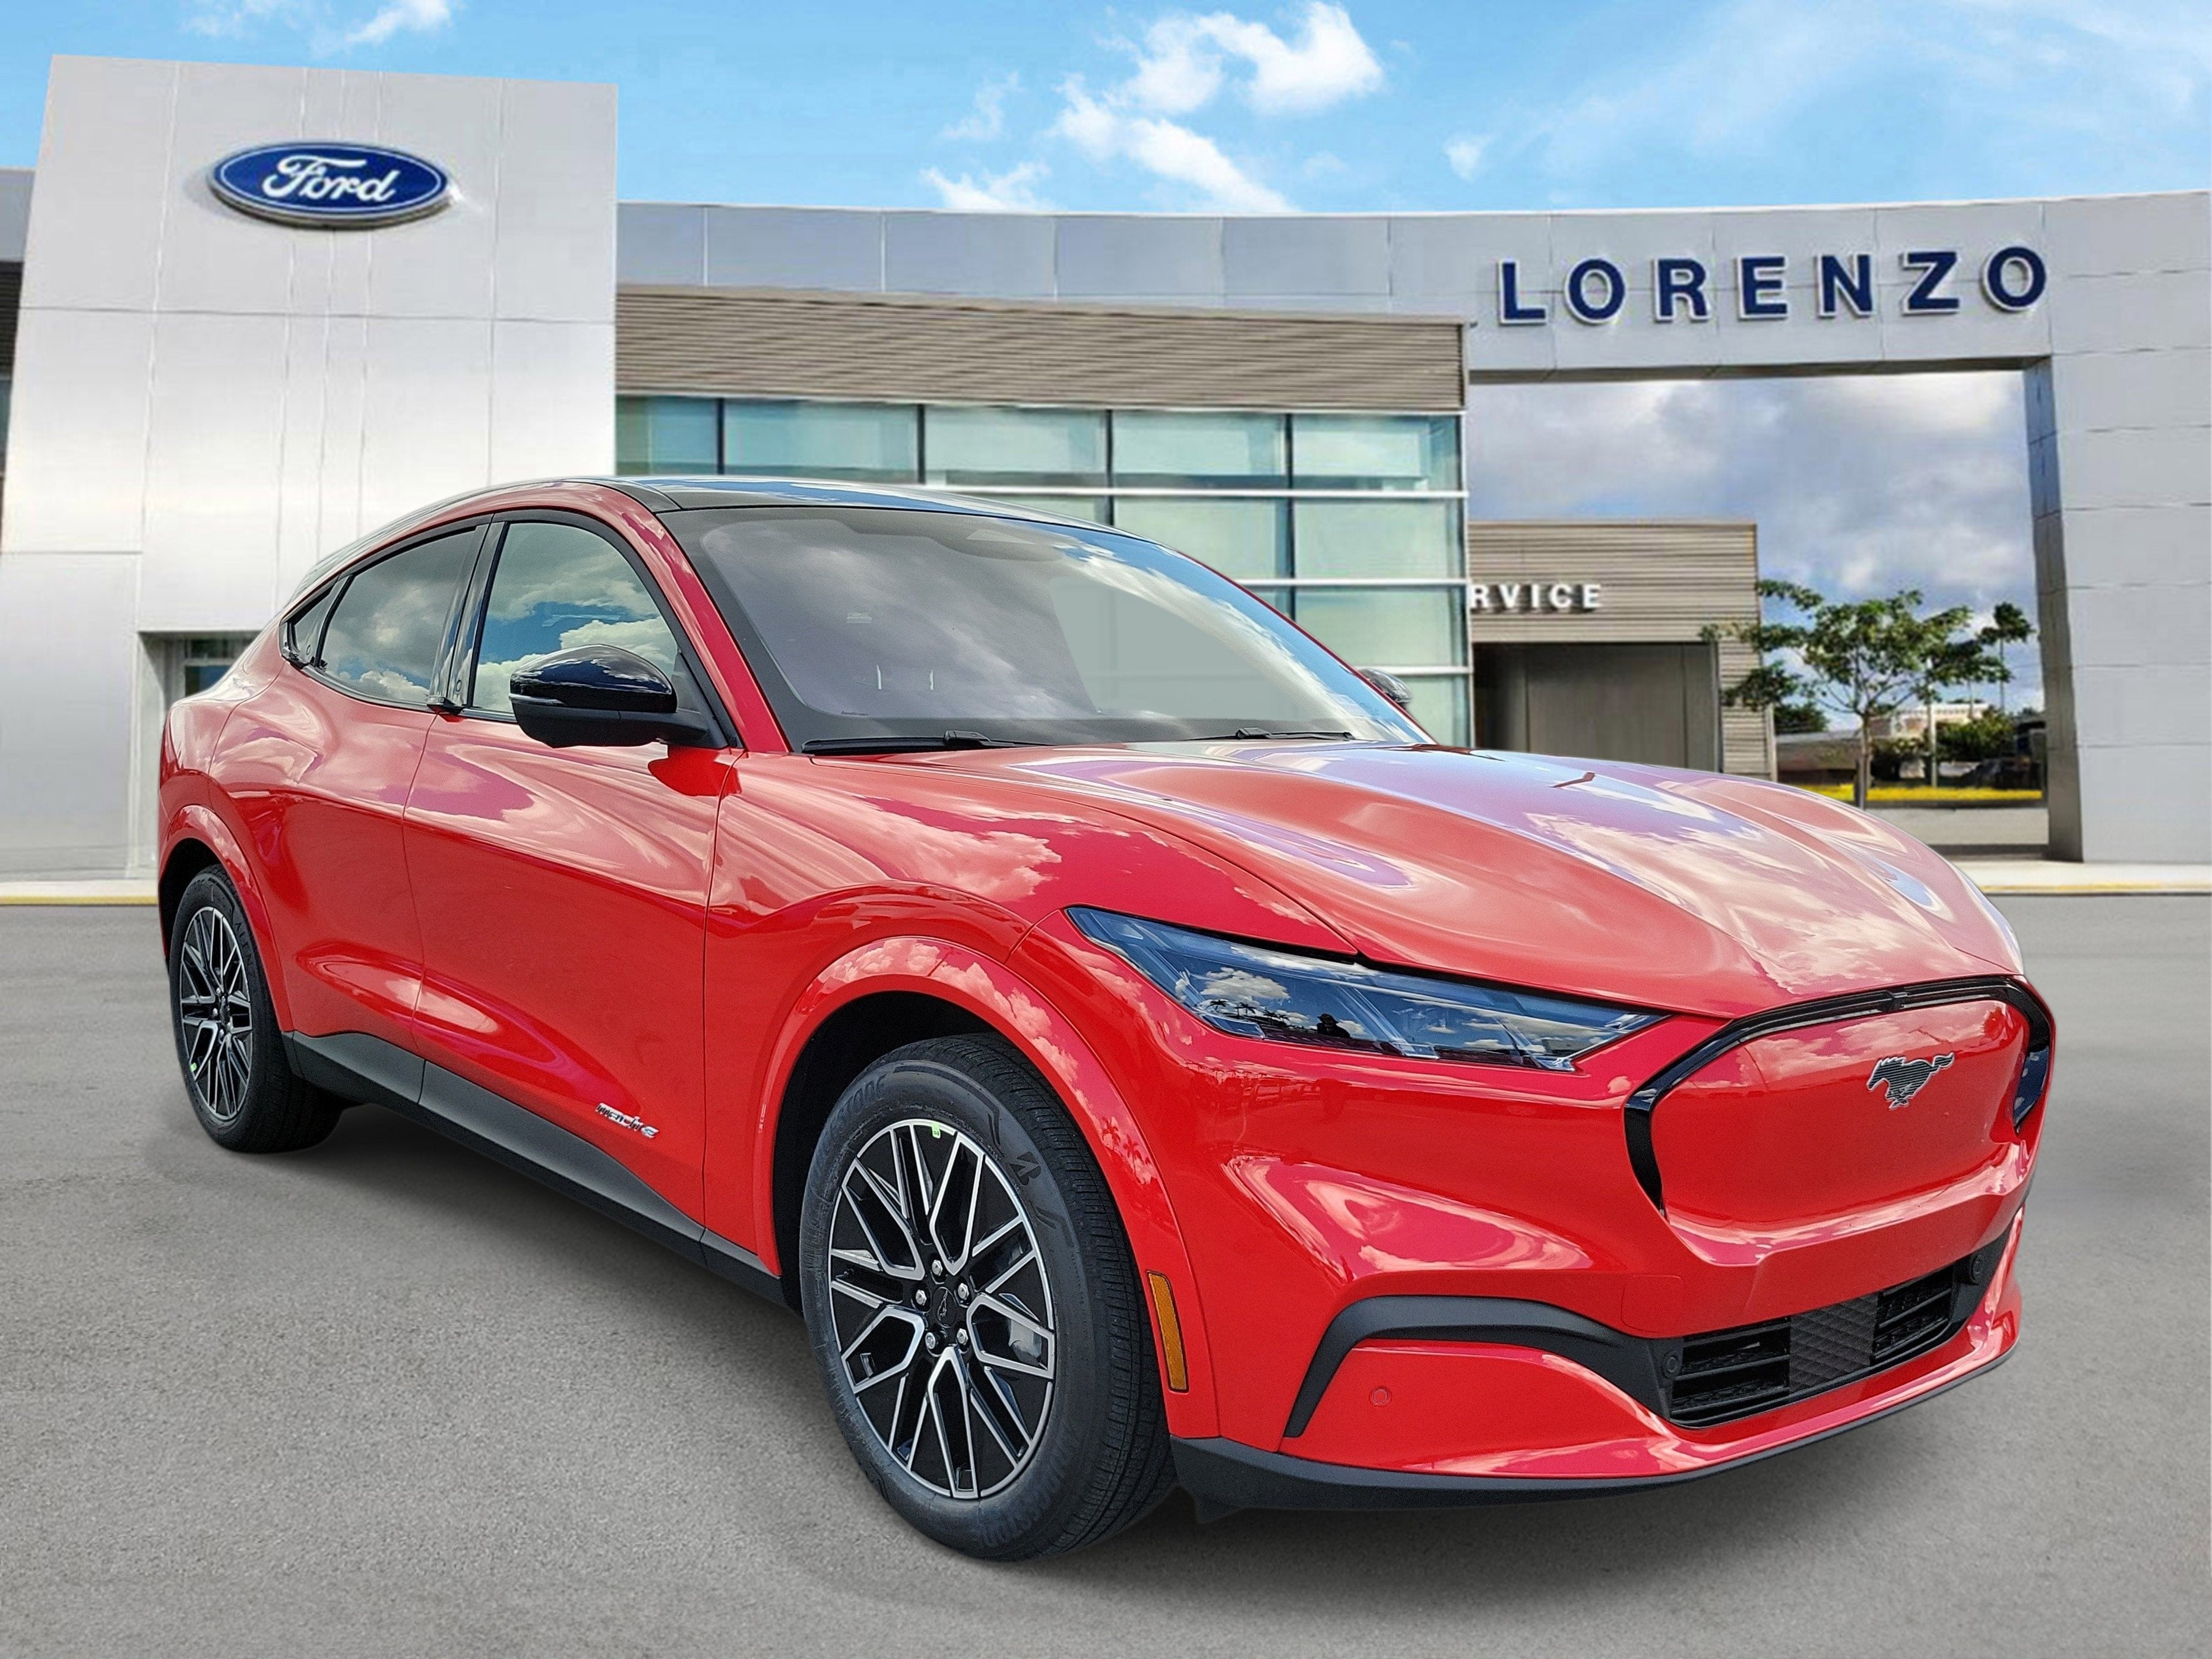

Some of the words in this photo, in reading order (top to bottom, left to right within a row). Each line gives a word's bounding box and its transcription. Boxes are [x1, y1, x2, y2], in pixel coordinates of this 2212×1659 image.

[262, 155, 399, 201] Ford
[1499, 244, 2048, 323] LORENZO
[1470, 584, 1602, 608] RVICE
